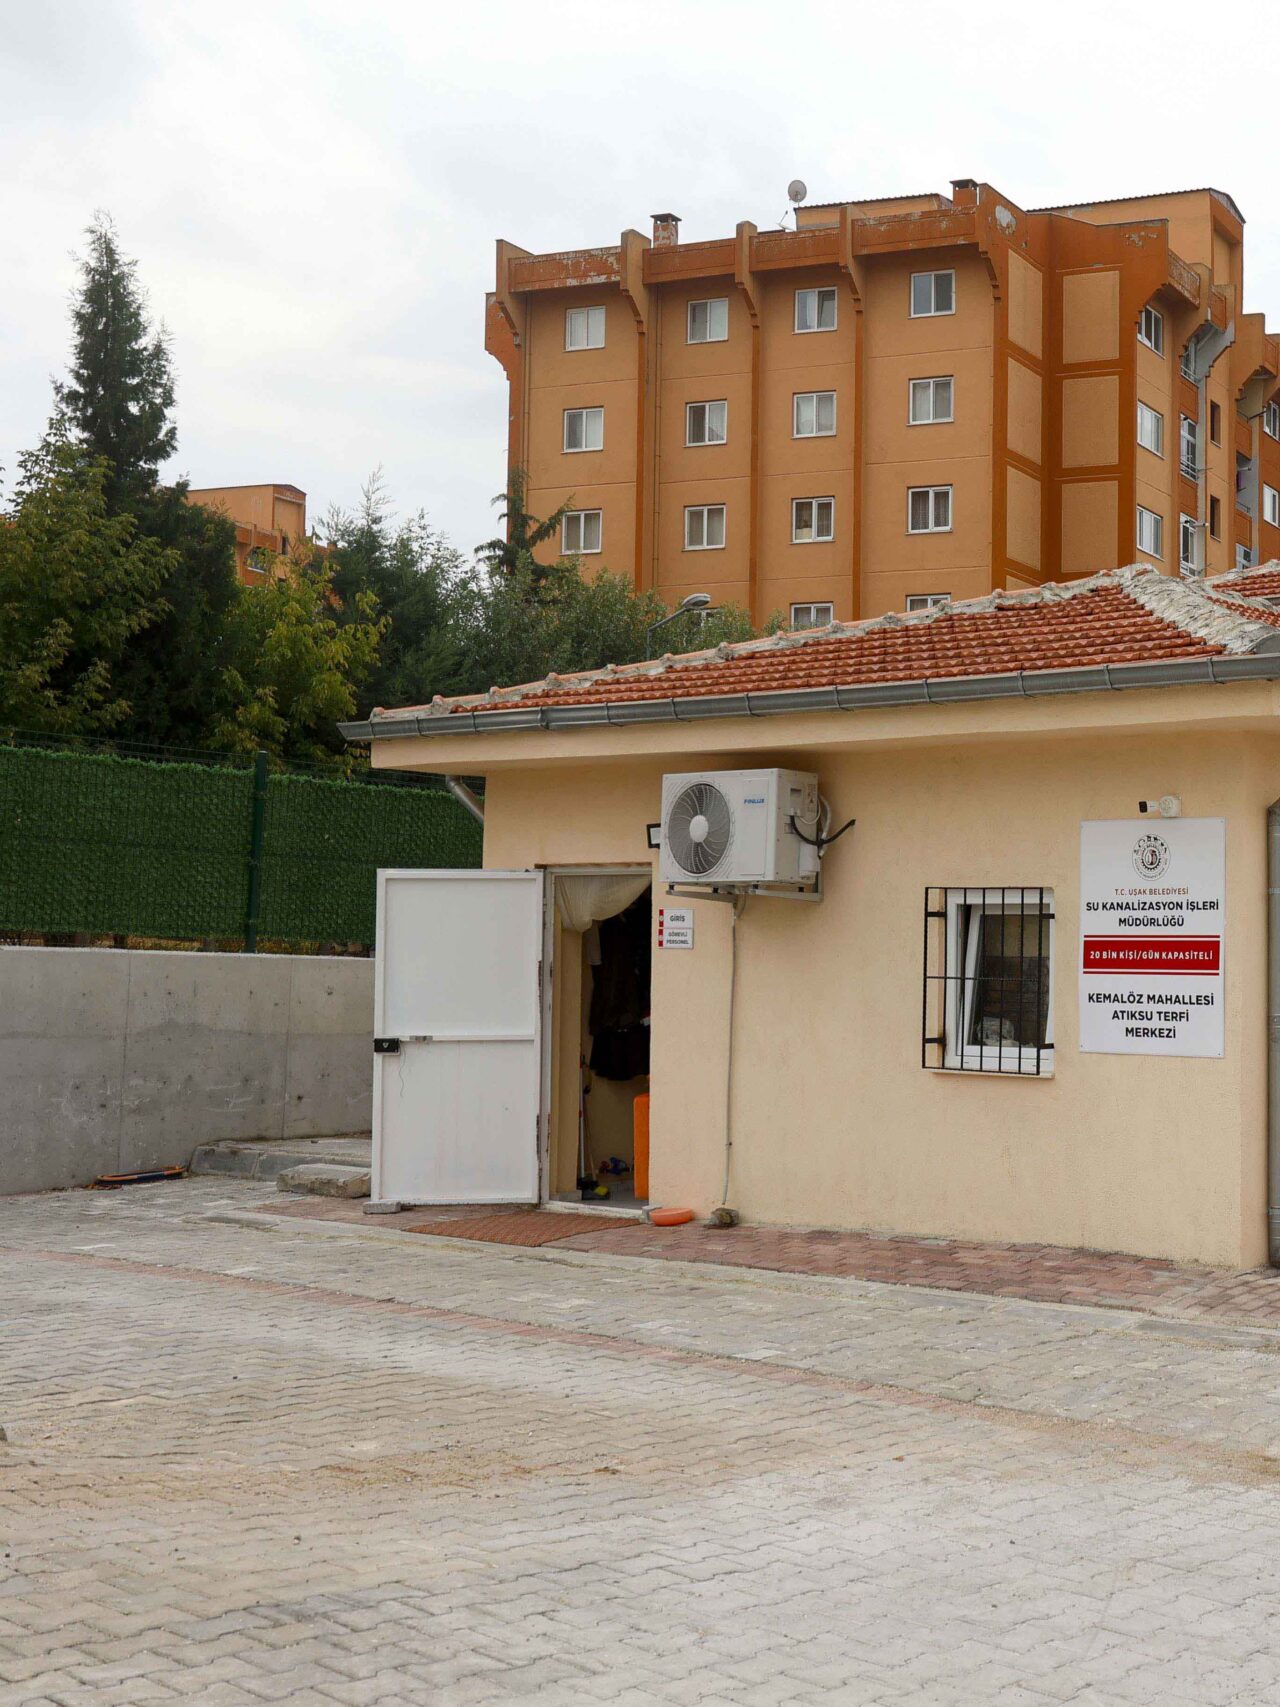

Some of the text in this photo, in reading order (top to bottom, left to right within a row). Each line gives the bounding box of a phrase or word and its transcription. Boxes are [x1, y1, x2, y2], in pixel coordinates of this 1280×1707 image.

[1149, 887, 1189, 895] BELEDİYESİ
[1086, 899, 1219, 912] SU KANALİZASYON İŞLERİ
[1118, 914, 1185, 927] MÜDÜRLÜĞÜ
[1089, 949, 1213, 960] 20 BİN KİŞİ/GÜN KAPASİTELİ
[1088, 991, 1214, 1006] KEMALÖZ MAHALLESİ
[1111, 1009, 1189, 1022] ATIKSU TERFİ
[1125, 1026, 1176, 1039] MERKEZİ
